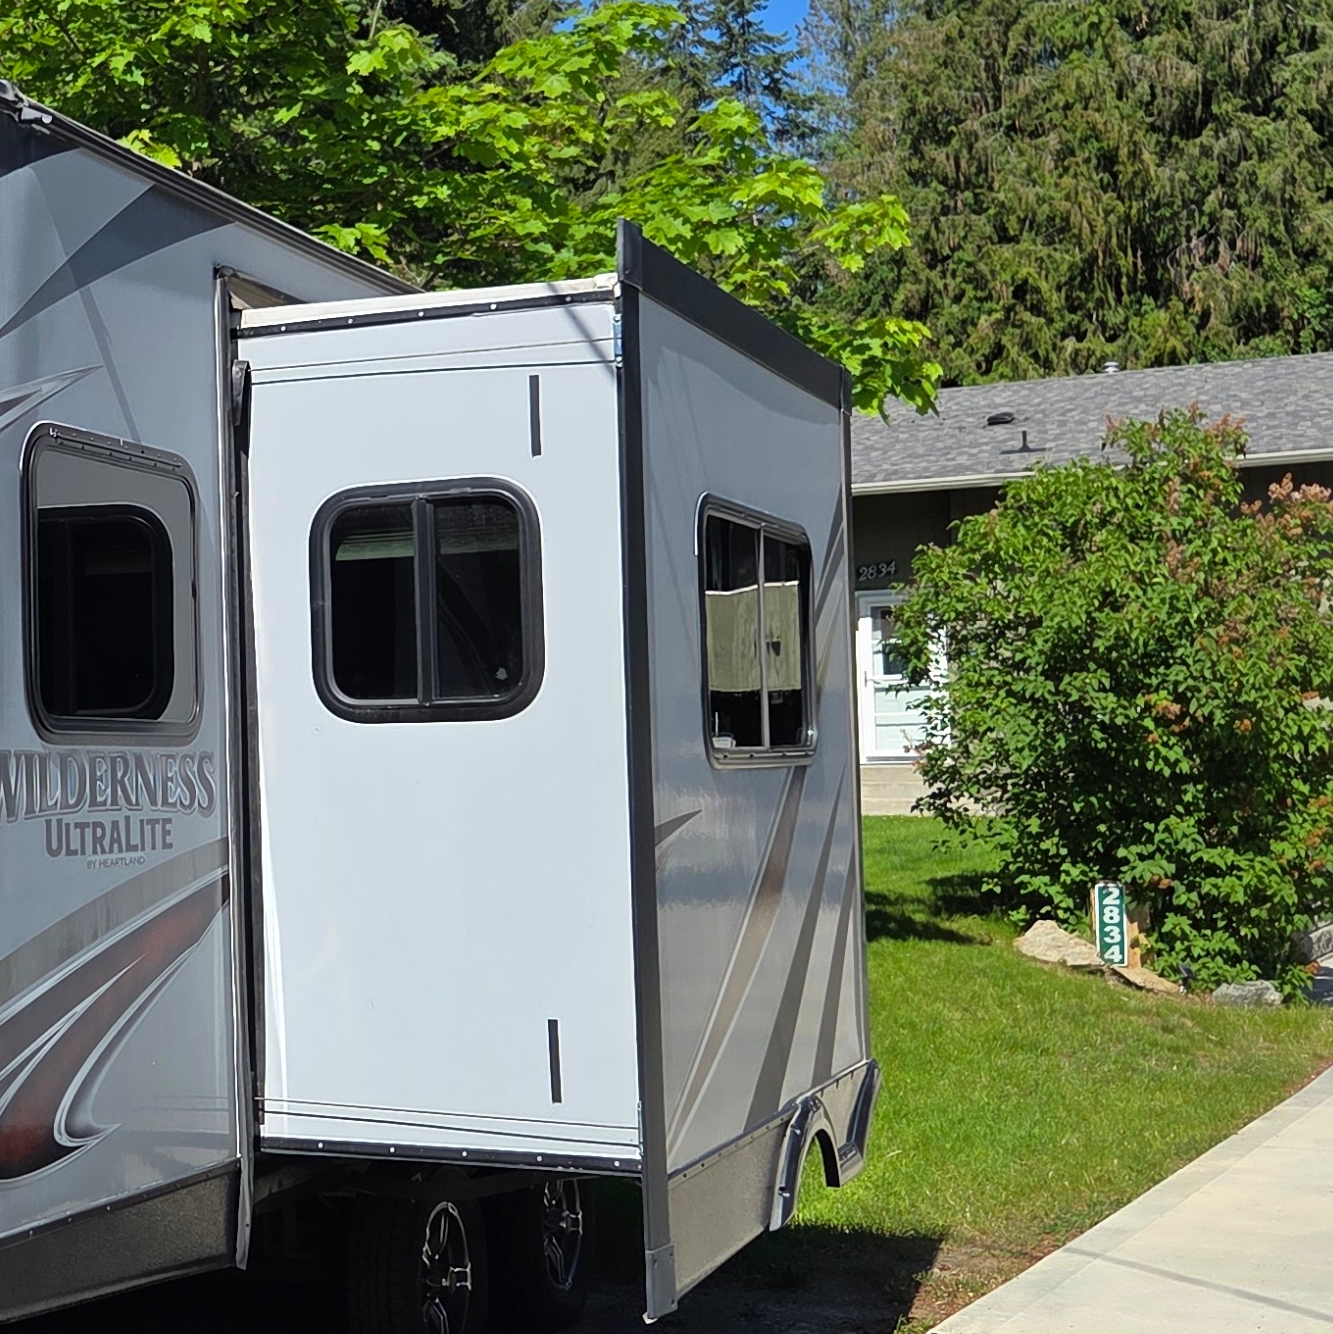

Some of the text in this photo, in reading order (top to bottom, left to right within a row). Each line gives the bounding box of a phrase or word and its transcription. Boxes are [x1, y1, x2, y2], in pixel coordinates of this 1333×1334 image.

[86, 855, 146, 870] BY HEARTLAND
[1102, 887, 1123, 963] 2834
